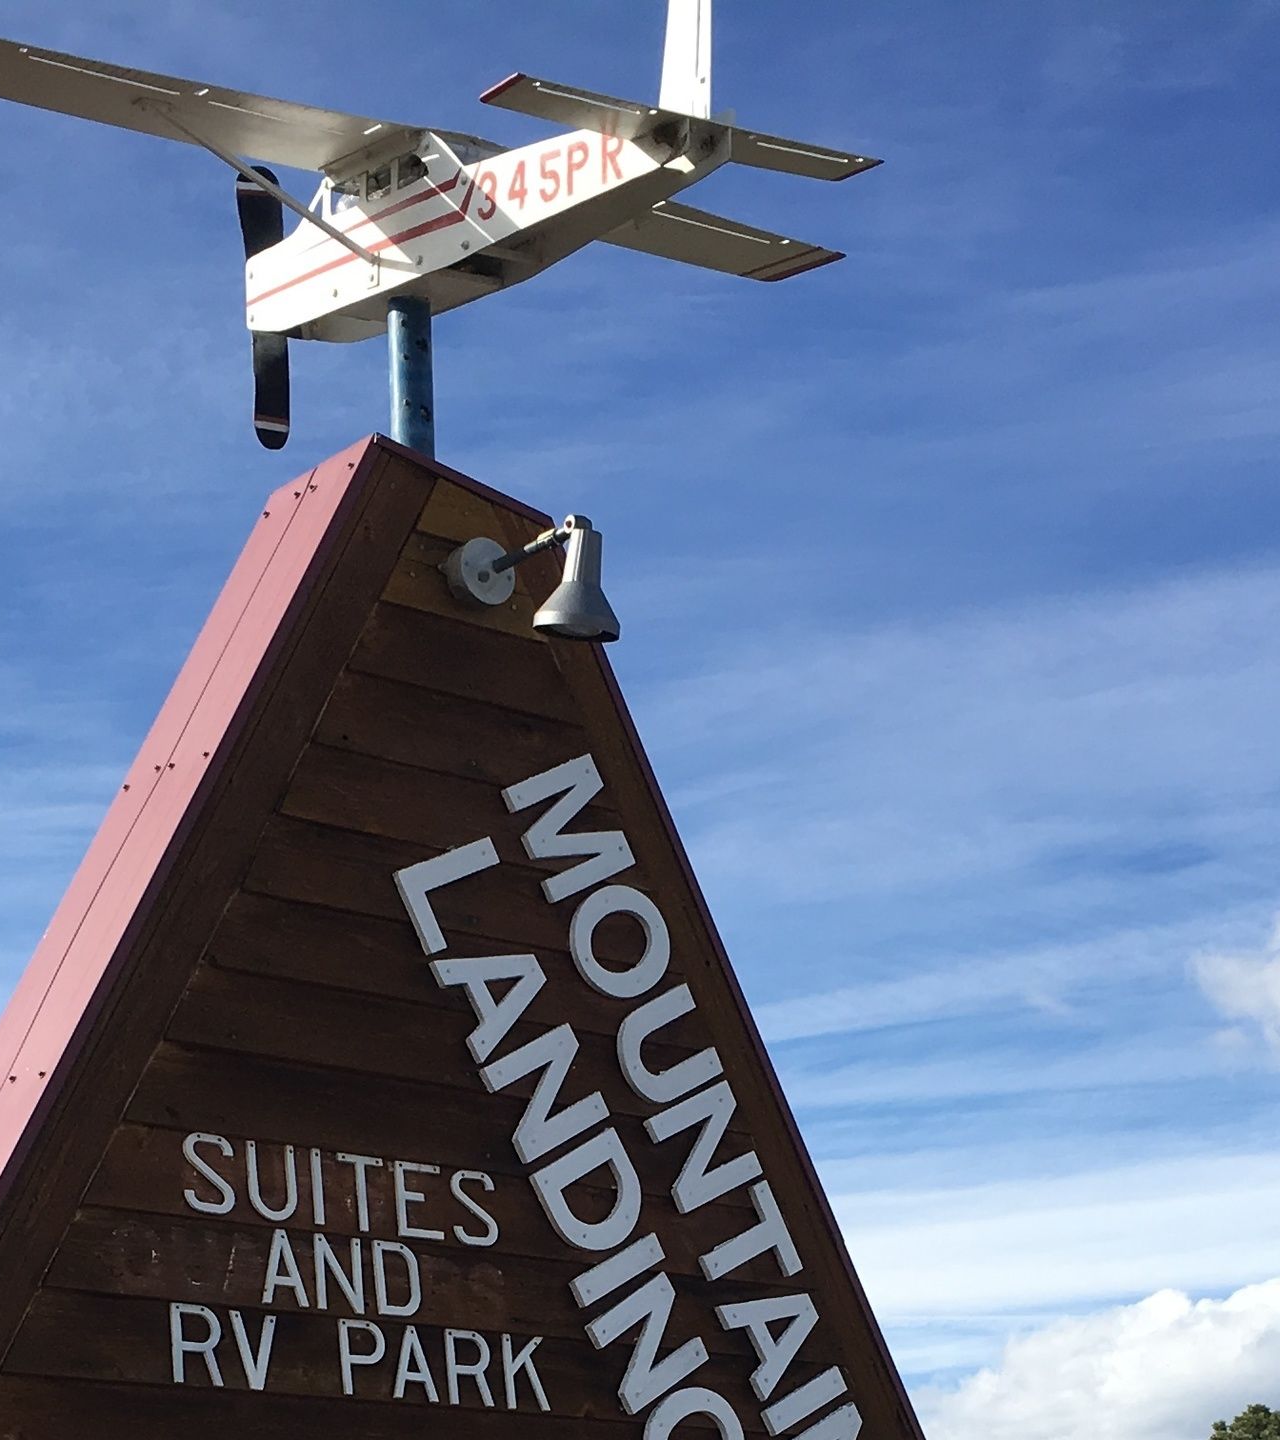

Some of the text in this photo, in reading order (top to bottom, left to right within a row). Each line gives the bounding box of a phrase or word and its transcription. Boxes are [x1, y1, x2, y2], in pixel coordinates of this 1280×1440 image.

[181, 1132, 500, 1247] SUITES
[262, 1229, 422, 1317] AND
[168, 1302, 552, 1412] RV PARK
